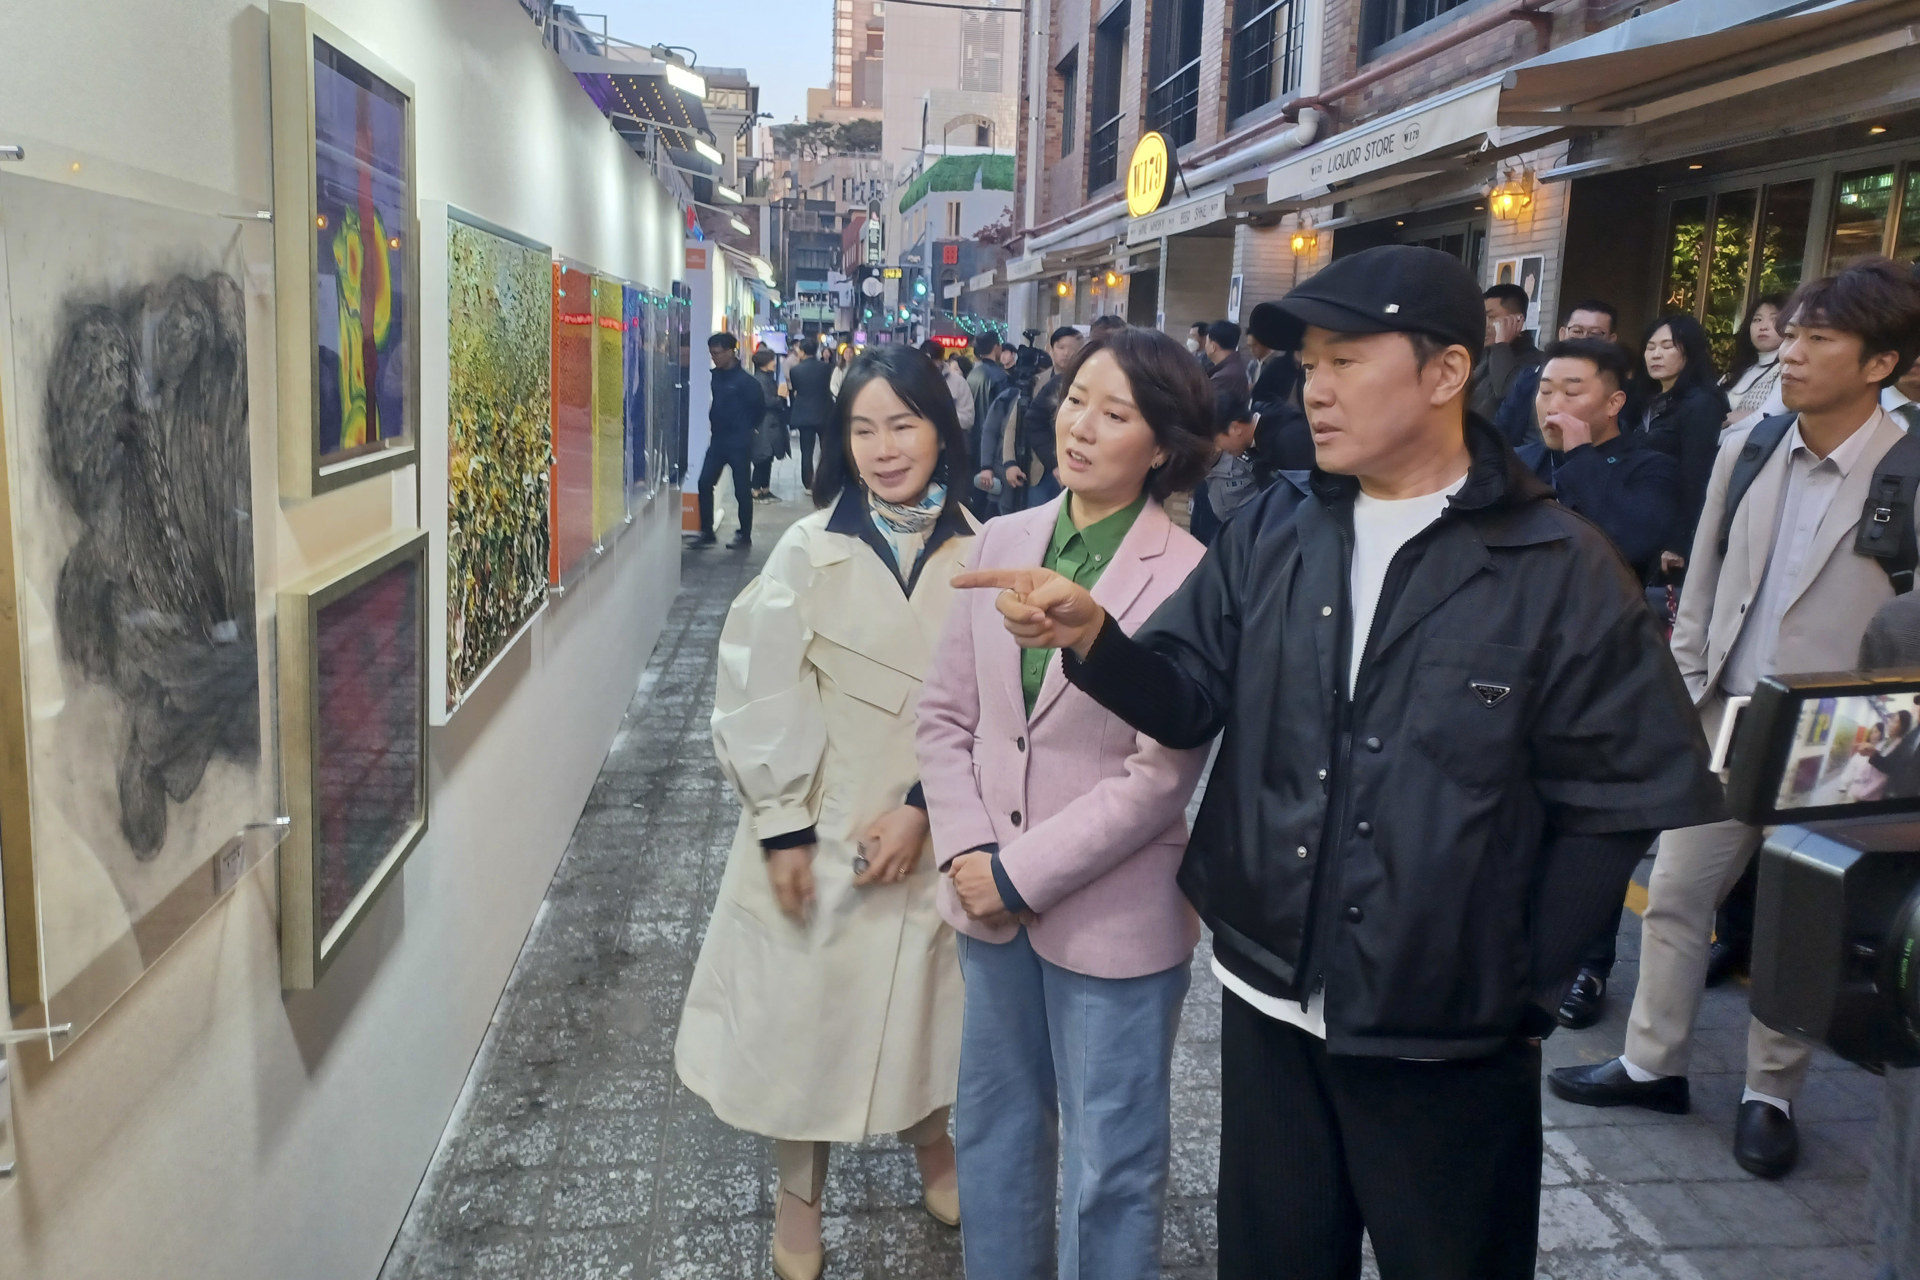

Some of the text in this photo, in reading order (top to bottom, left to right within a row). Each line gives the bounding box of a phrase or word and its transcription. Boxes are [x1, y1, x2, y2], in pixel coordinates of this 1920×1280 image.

[1328, 146, 1361, 174] LIQUOR
[1365, 133, 1396, 162] STORE
[1403, 129, 1420, 143] W179
[1133, 152, 1163, 198] W179
